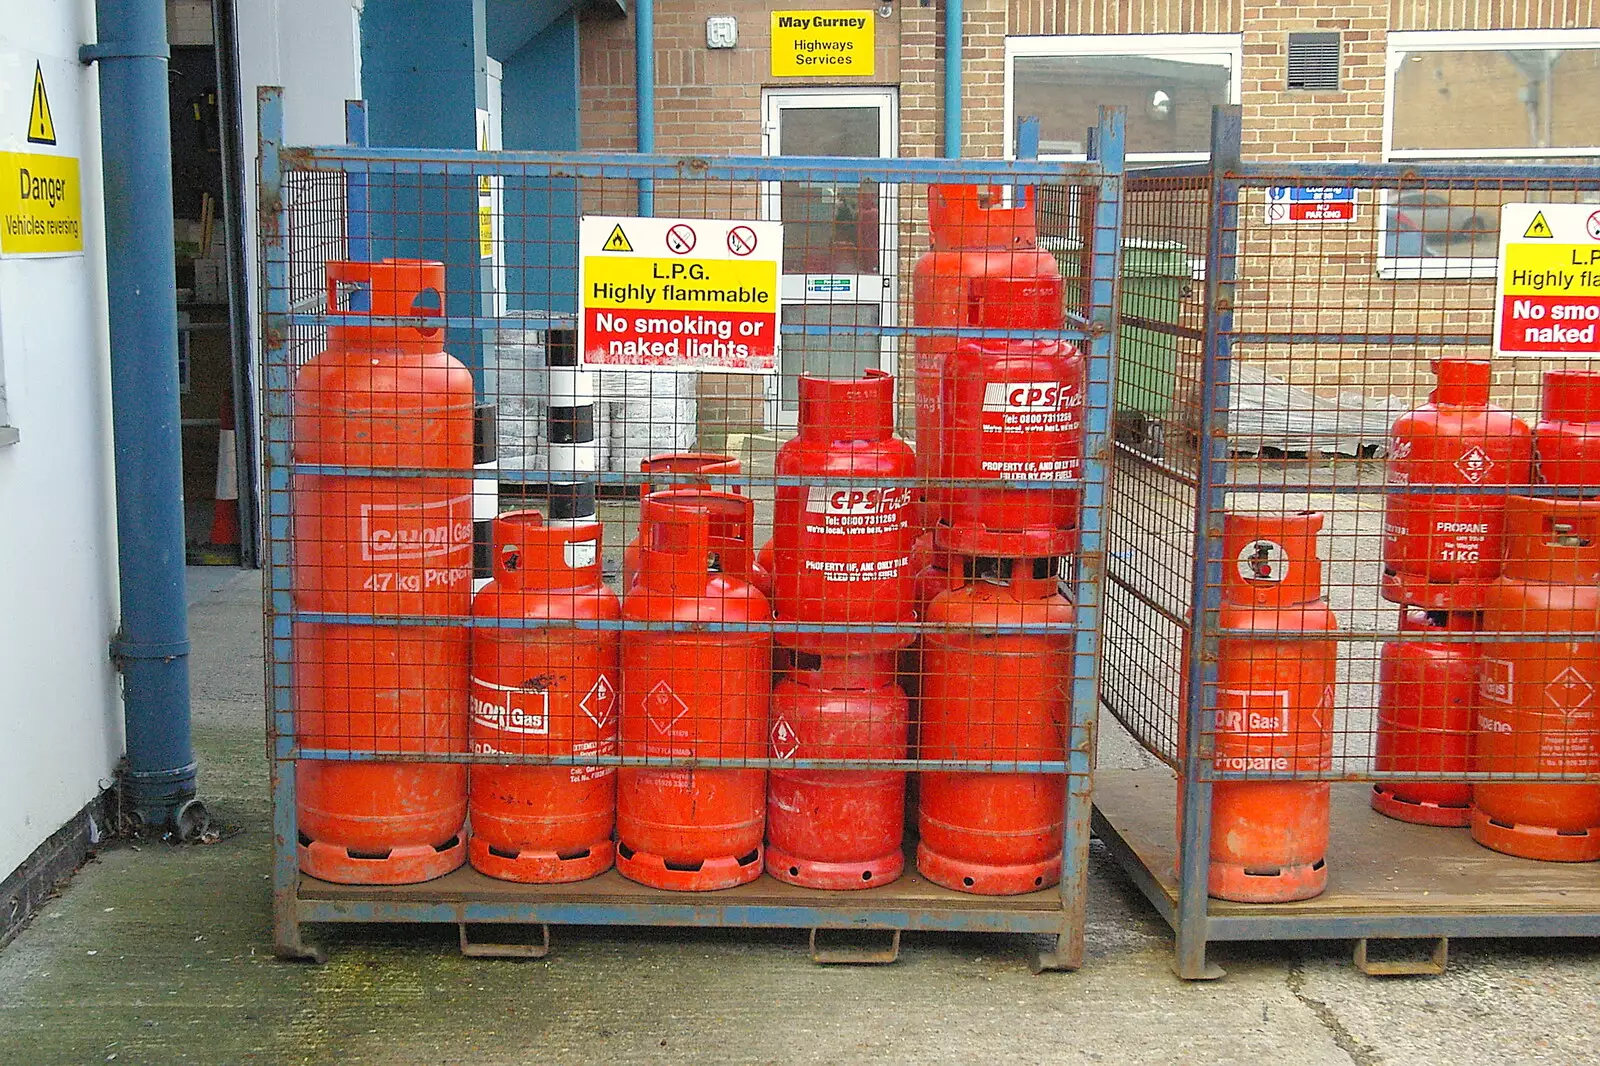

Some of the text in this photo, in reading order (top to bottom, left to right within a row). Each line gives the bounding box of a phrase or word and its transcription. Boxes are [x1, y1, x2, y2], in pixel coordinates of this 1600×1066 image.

[779, 16, 866, 30] May Gurney
[794, 40, 853, 52] Highways
[796, 54, 852, 65] Services
[20, 168, 65, 208] Danger
[1316, 203, 1330, 211] NO
[5, 214, 78, 239] Vehicles reversing
[653, 263, 710, 280] L.P.G.
[1512, 270, 1574, 290] Highly
[593, 283, 768, 303] Highly flammable
[1513, 300, 1545, 320] No
[596, 313, 764, 337] No smoking or
[1525, 324, 1595, 344] naked
[609, 338, 749, 358] naked lights
[1008, 387, 1057, 407] CPS
[1002, 413, 1018, 424] Tel:
[1020, 413, 1042, 424] 0800
[982, 461, 1023, 471] PROPERTY
[1038, 461, 1054, 471] AND
[830, 490, 880, 510] CPS
[825, 513, 897, 525] Tel: 0800 7311269
[1436, 522, 1488, 533] PROPANE
[806, 525, 825, 534] We're
[826, 526, 846, 535] local,
[806, 560, 845, 571] PROPERTY
[877, 559, 894, 570] ONLY
[363, 573, 393, 591] 47
[395, 572, 421, 592] kg
[511, 708, 542, 727] Gas
[1249, 713, 1279, 729] Gas
[1216, 752, 1288, 771] Propane
